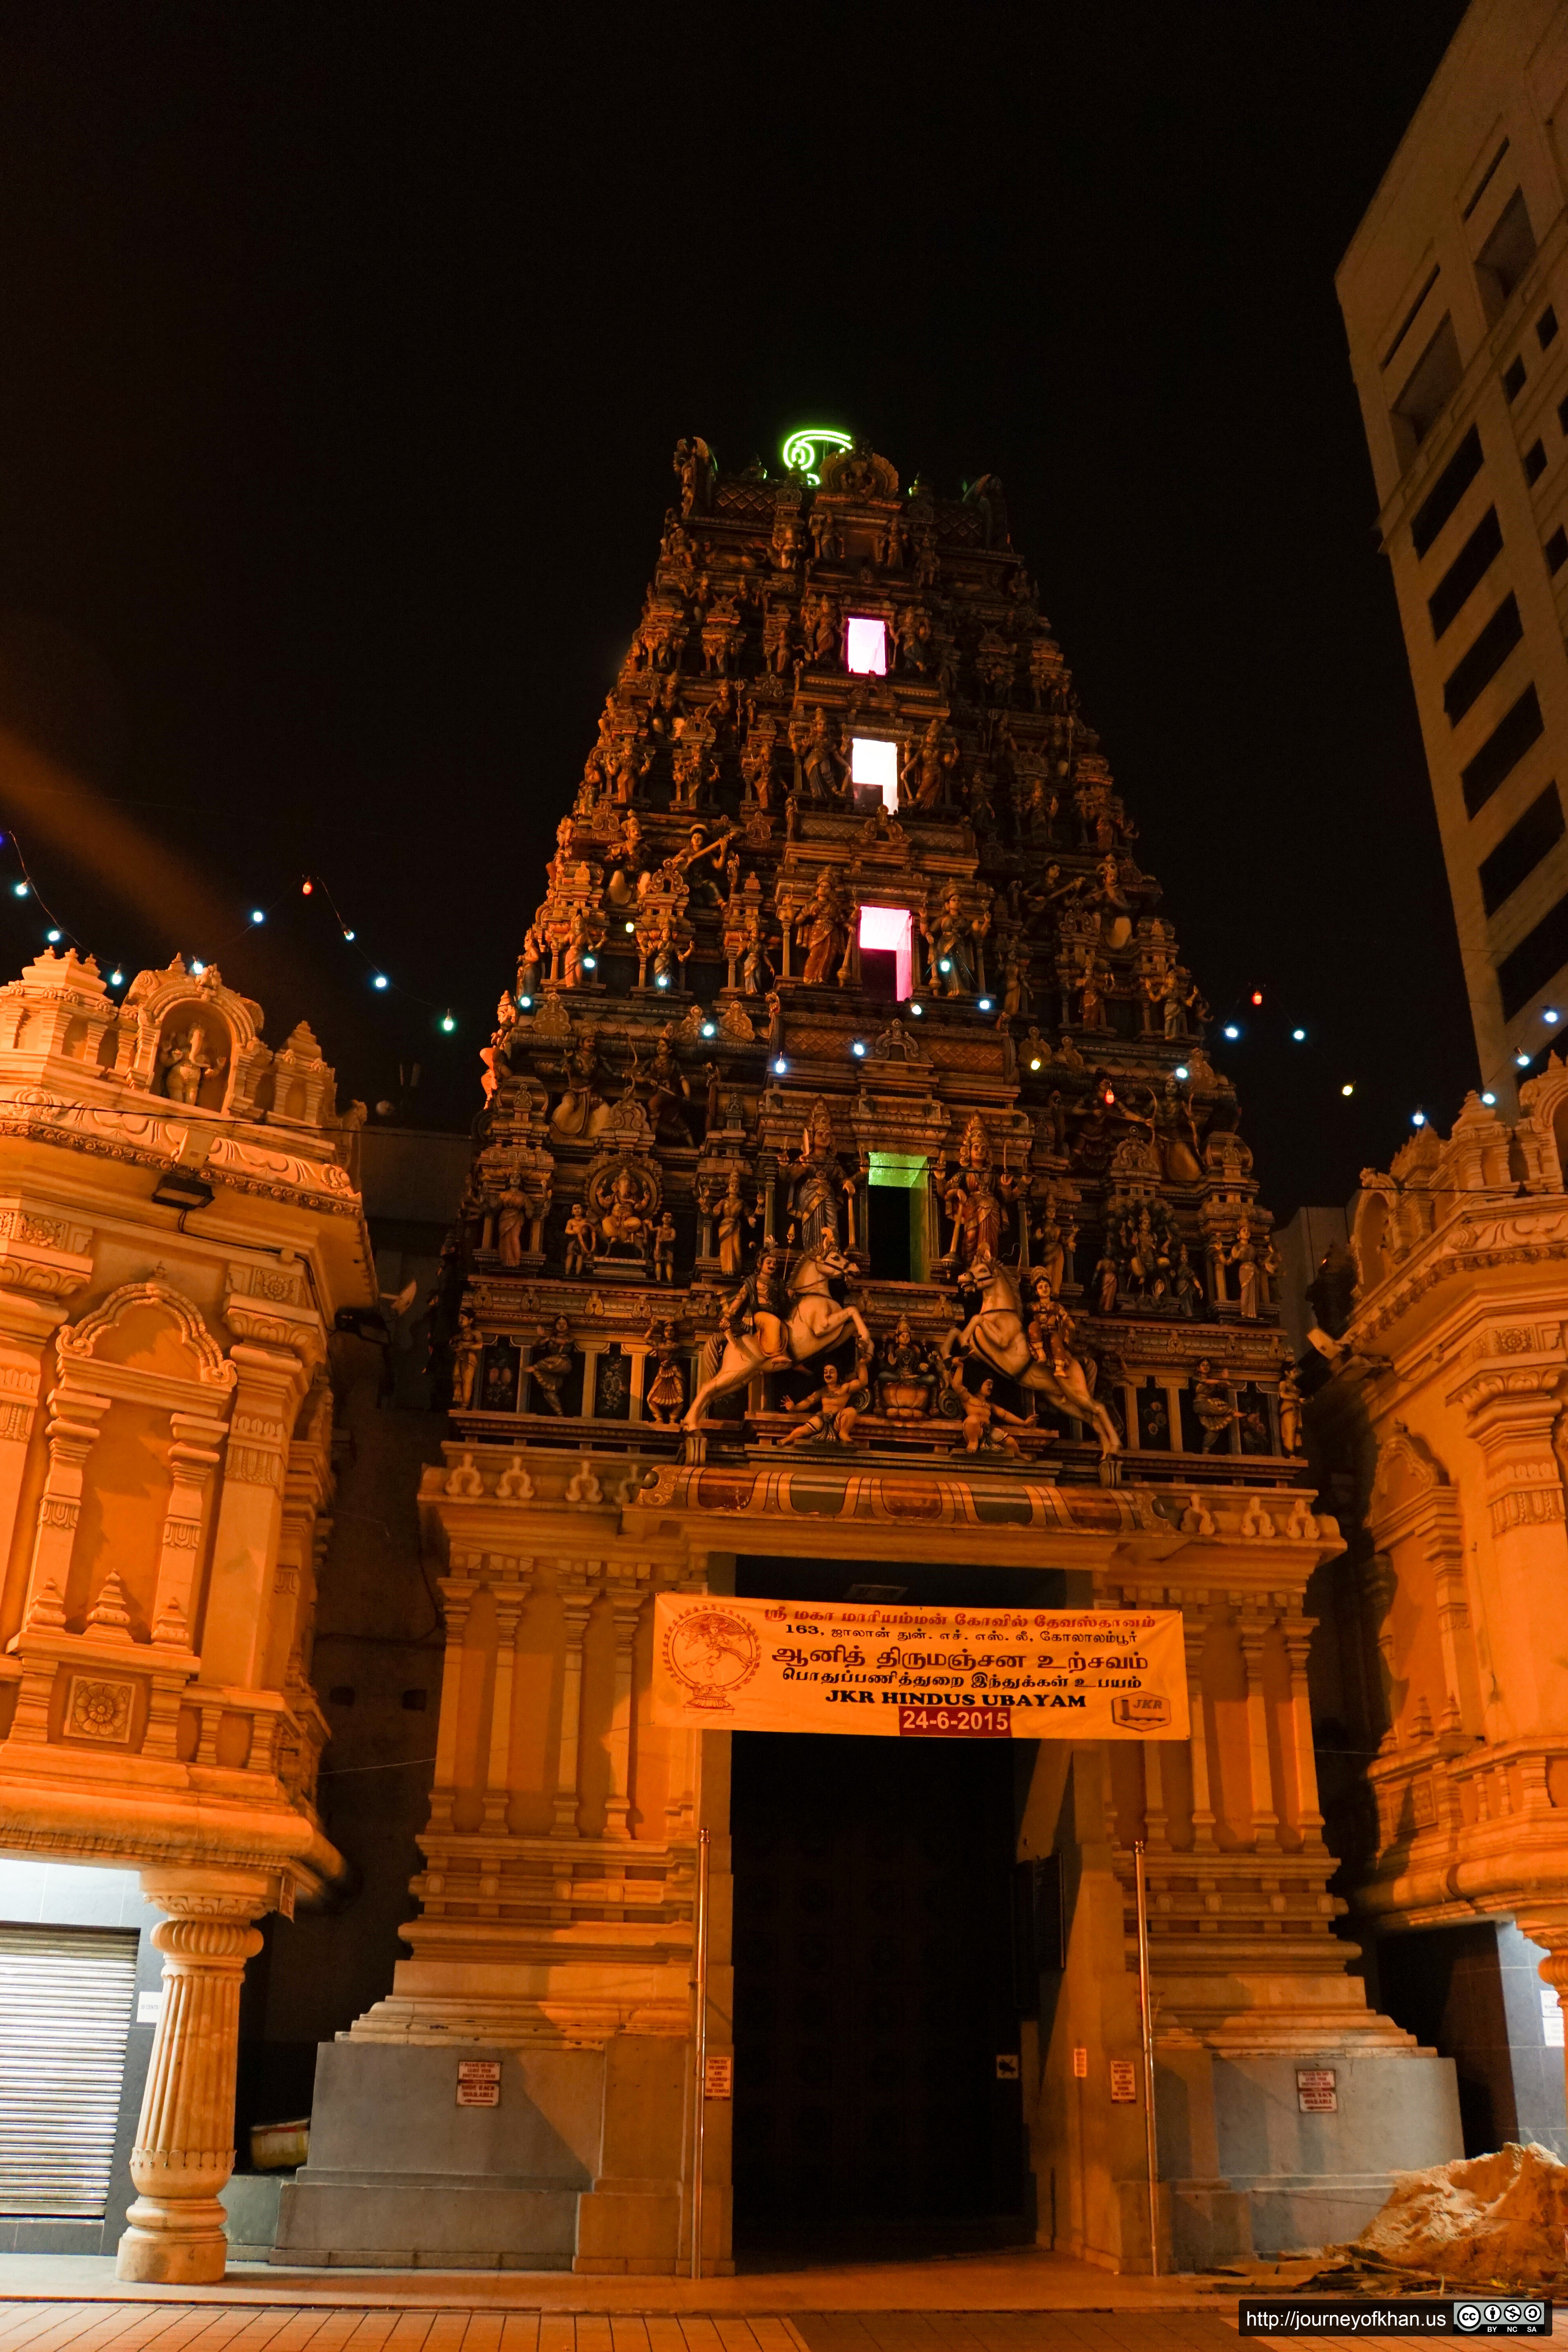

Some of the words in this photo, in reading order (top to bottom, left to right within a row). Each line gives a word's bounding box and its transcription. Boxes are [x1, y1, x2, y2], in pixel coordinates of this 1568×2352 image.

[794, 1611, 835, 1621] மகா
[840, 1610, 947, 1626] மாரியம்மன்
[955, 1613, 1028, 1627] கோவில்
[1034, 1615, 1155, 1630] தேவஸ்தானம்
[786, 1624, 824, 1636] 163,
[831, 1626, 890, 1637] ஜாலான்
[1040, 1630, 1137, 1646] கோலாலம்பூர்
[772, 1644, 866, 1668] ஆனித்
[877, 1646, 1027, 1671] திருமஞ்சன
[1038, 1651, 1148, 1673] உற்சவம்
[971, 1672, 1069, 1690] இந்துக்கள்
[825, 1690, 875, 1704] JKR
[882, 1692, 975, 1706] HINDUS
[983, 1694, 1086, 1707] UBAYAM
[1133, 1700, 1162, 1709] JKR
[904, 1711, 1007, 1730] 24-6-2015
